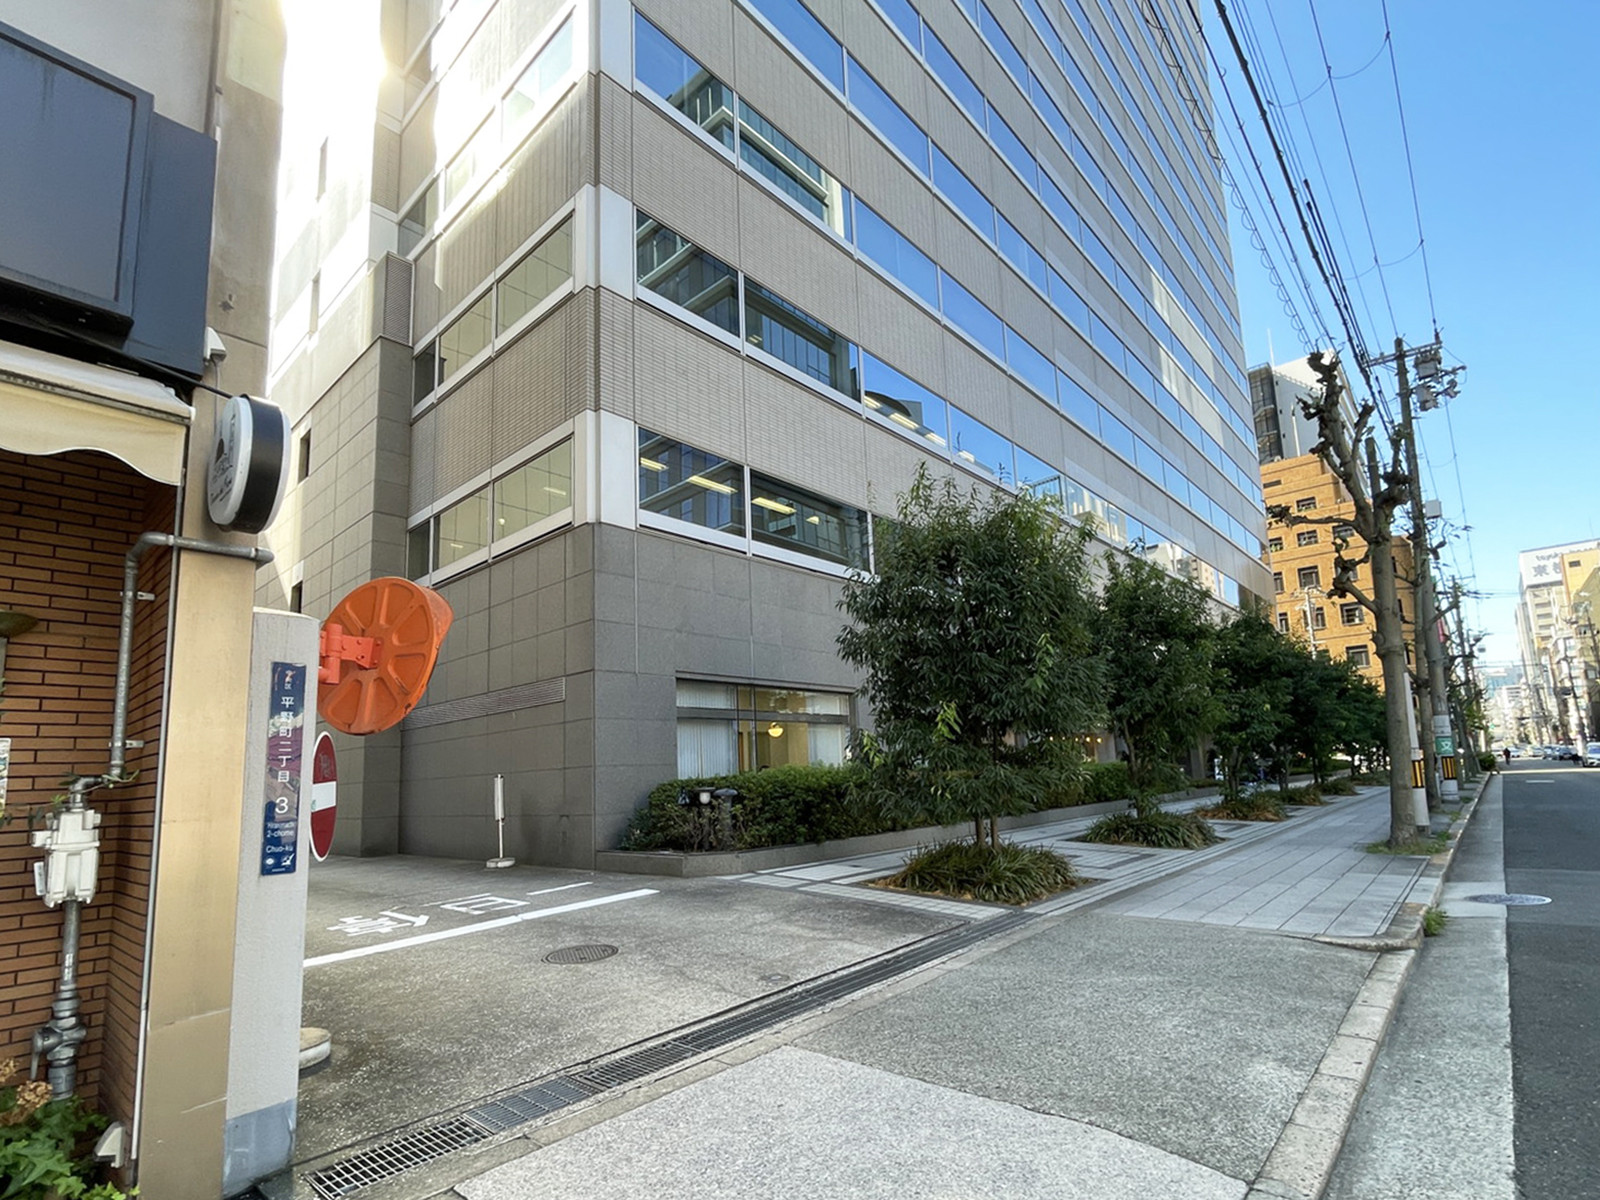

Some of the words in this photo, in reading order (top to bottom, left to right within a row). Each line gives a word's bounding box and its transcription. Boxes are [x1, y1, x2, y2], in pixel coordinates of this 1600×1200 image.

[277, 696, 294, 783] 平野町二丁目
[275, 796, 289, 814] 3
[266, 829, 295, 838] 2-chome
[265, 844, 293, 854] Chuo-ku
